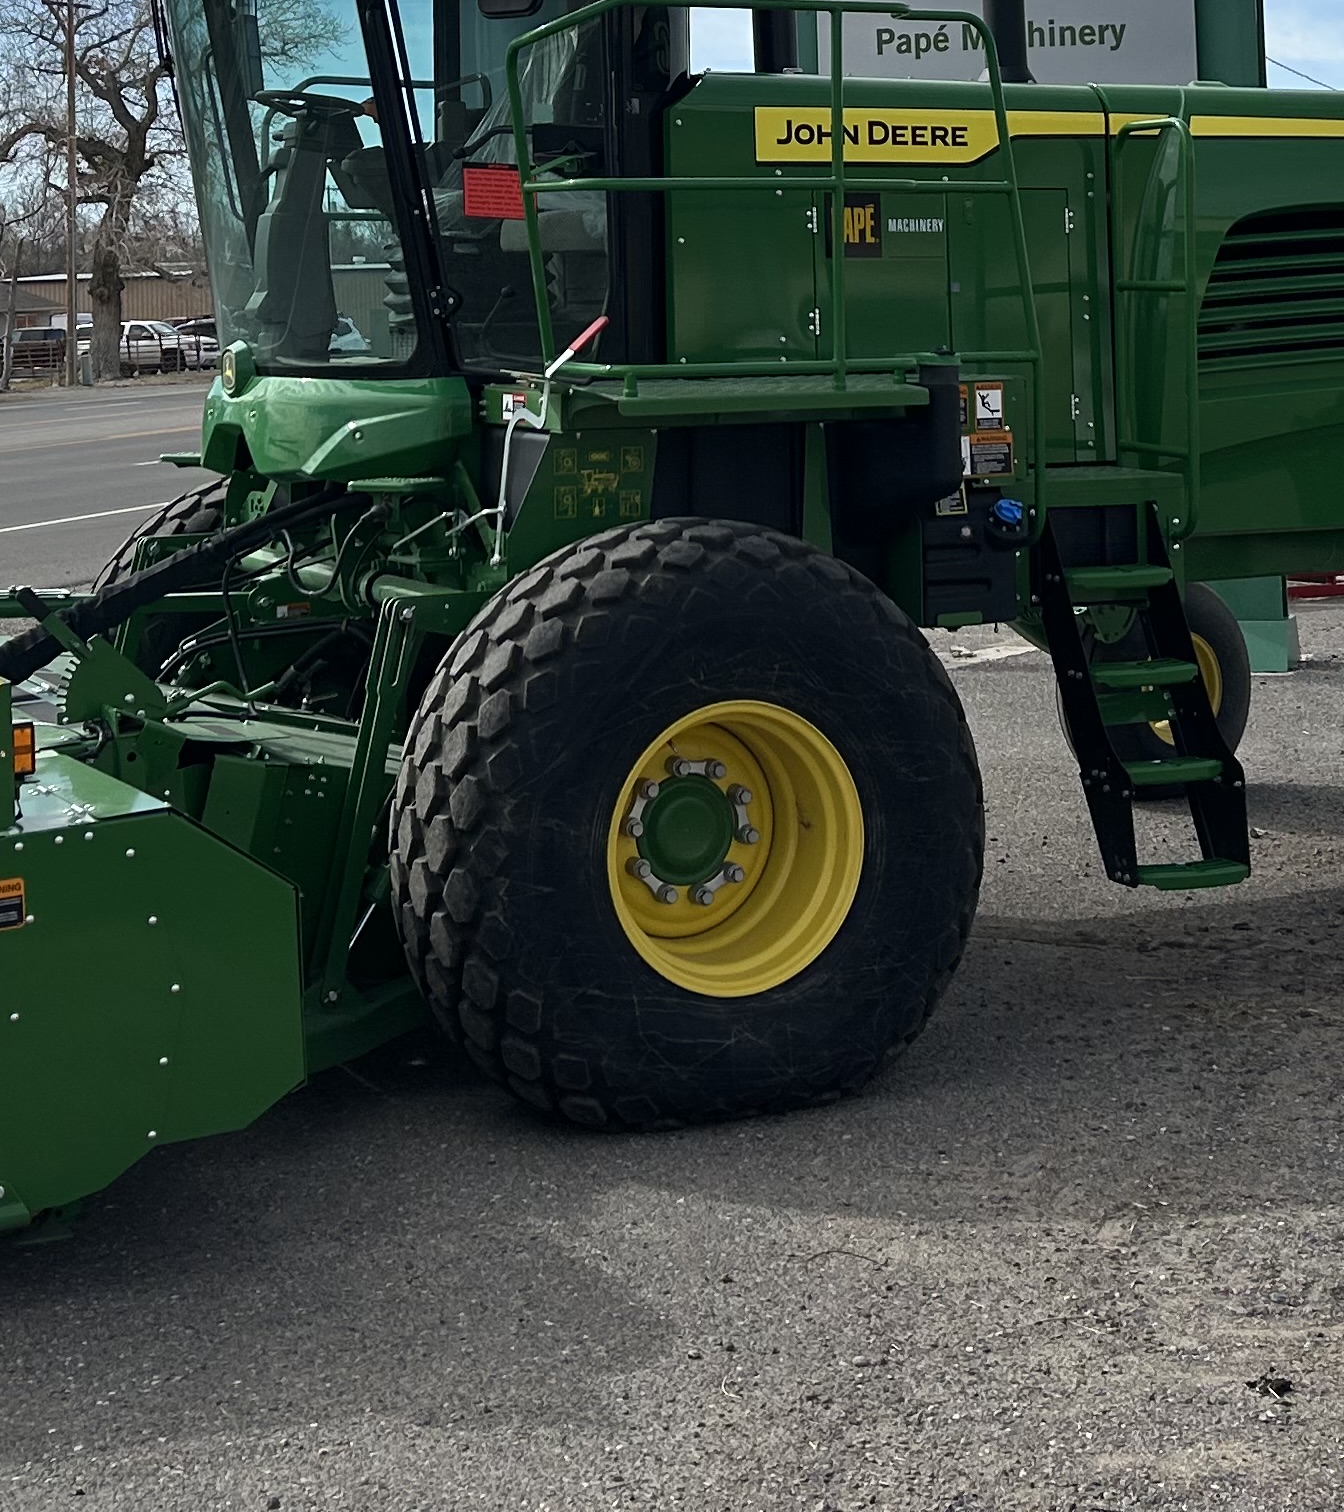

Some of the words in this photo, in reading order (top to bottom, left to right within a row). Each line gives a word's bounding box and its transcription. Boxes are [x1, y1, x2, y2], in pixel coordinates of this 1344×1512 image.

[875, 23, 951, 59] Papé
[961, 18, 1127, 52] Mhinery
[867, 120, 969, 147] DEERE
[842, 204, 876, 243] APÉ
[887, 218, 945, 233] MACHINERY
